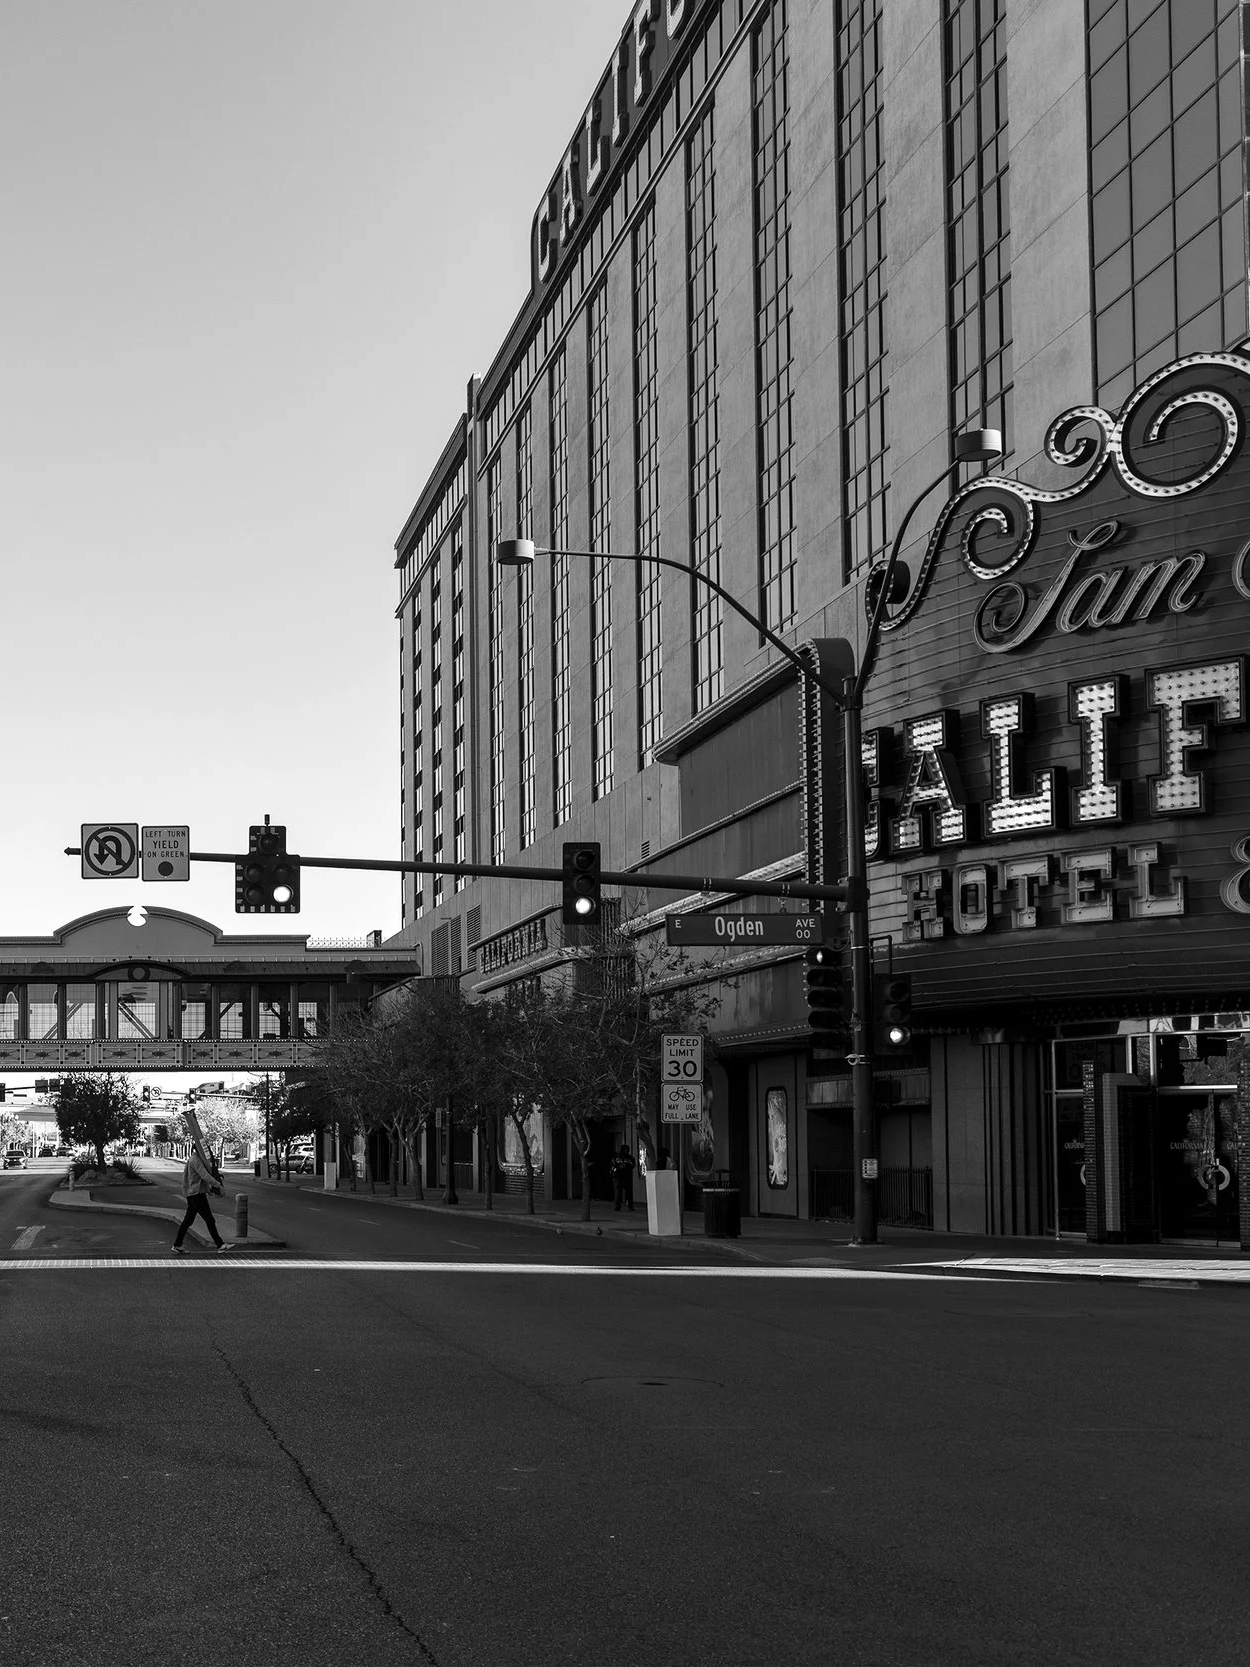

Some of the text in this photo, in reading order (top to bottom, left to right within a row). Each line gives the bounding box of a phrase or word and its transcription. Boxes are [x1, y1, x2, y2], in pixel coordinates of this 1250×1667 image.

[153, 840, 179, 849] YIELD
[901, 842, 1188, 942] HOTEL
[675, 916, 816, 942] E Ogden AVE
[795, 929, 811, 939] 00
[666, 1038, 699, 1047] SPEED
[667, 1060, 697, 1077] 30
